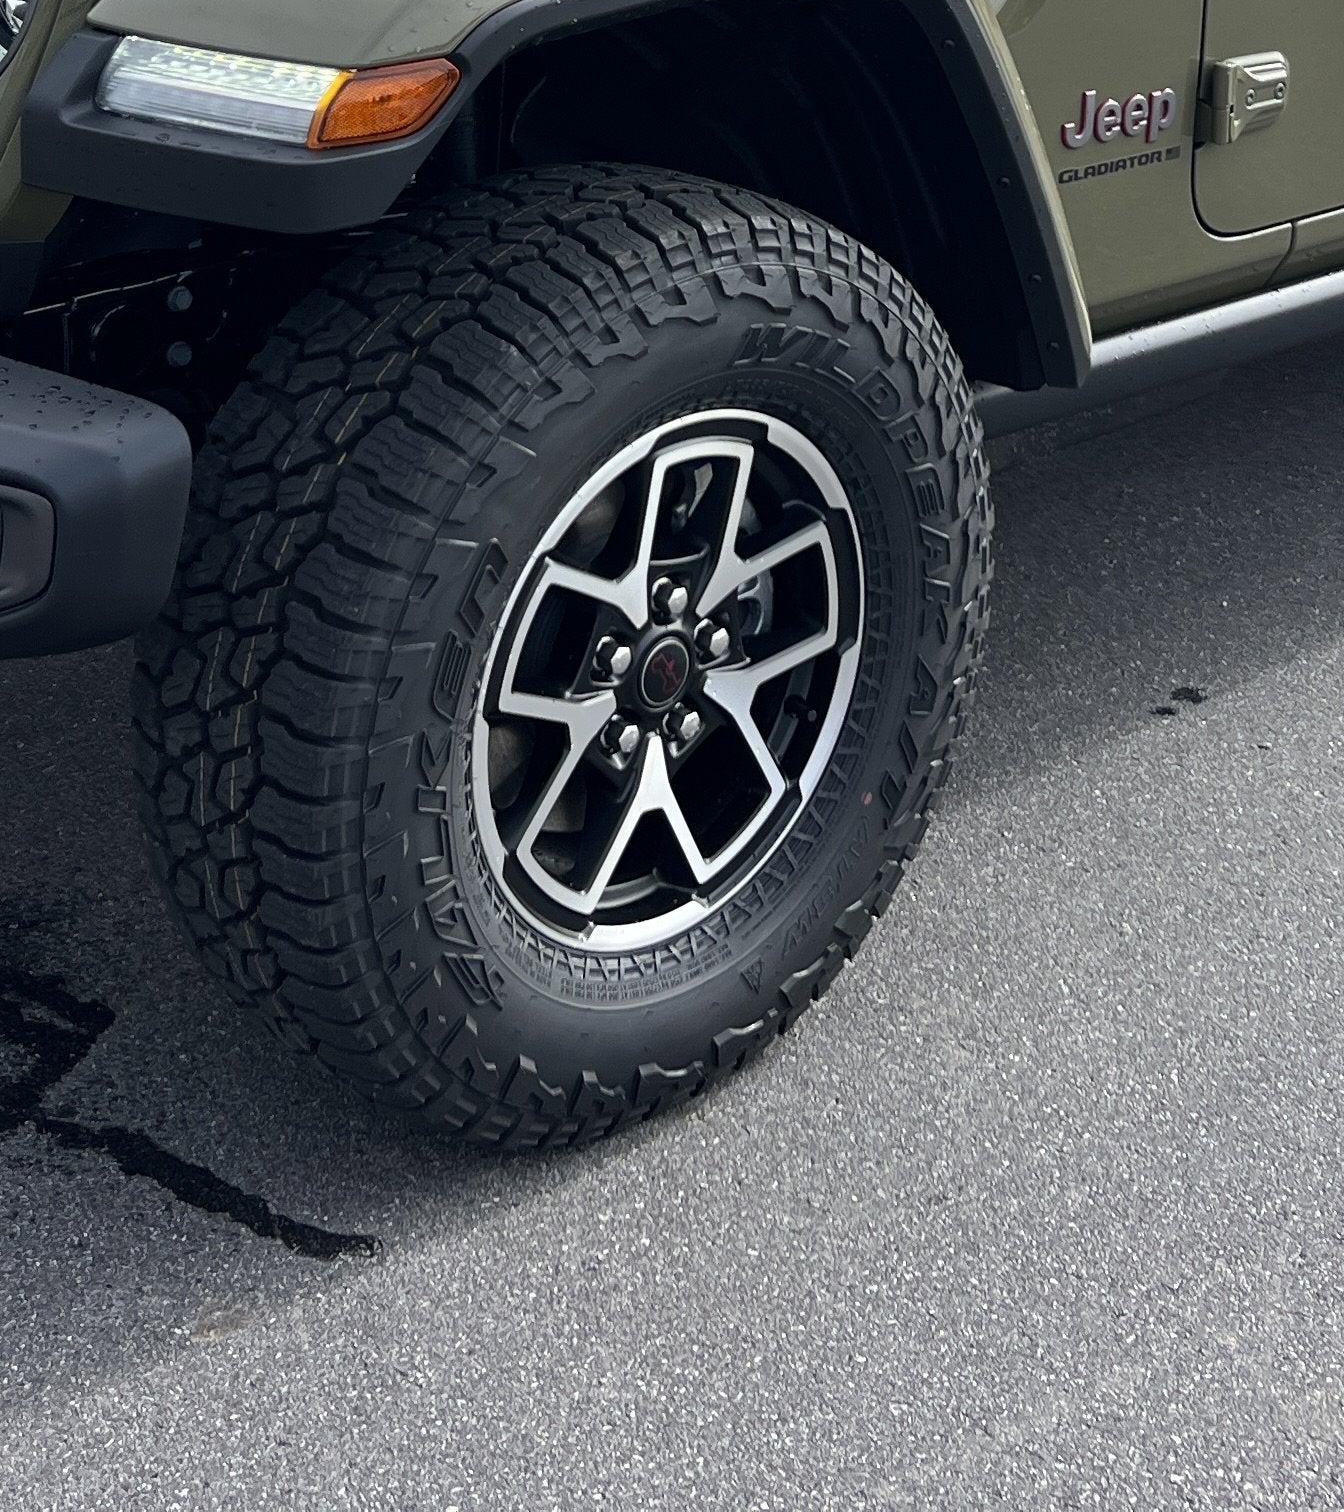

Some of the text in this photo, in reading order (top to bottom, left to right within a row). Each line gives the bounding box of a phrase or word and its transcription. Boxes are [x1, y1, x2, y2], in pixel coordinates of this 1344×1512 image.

[1058, 150, 1163, 185] GLADIATOR
[1060, 87, 1176, 150] Jeep
[726, 321, 954, 645] WILDPEAK
[416, 536, 510, 1011] FALKEN
